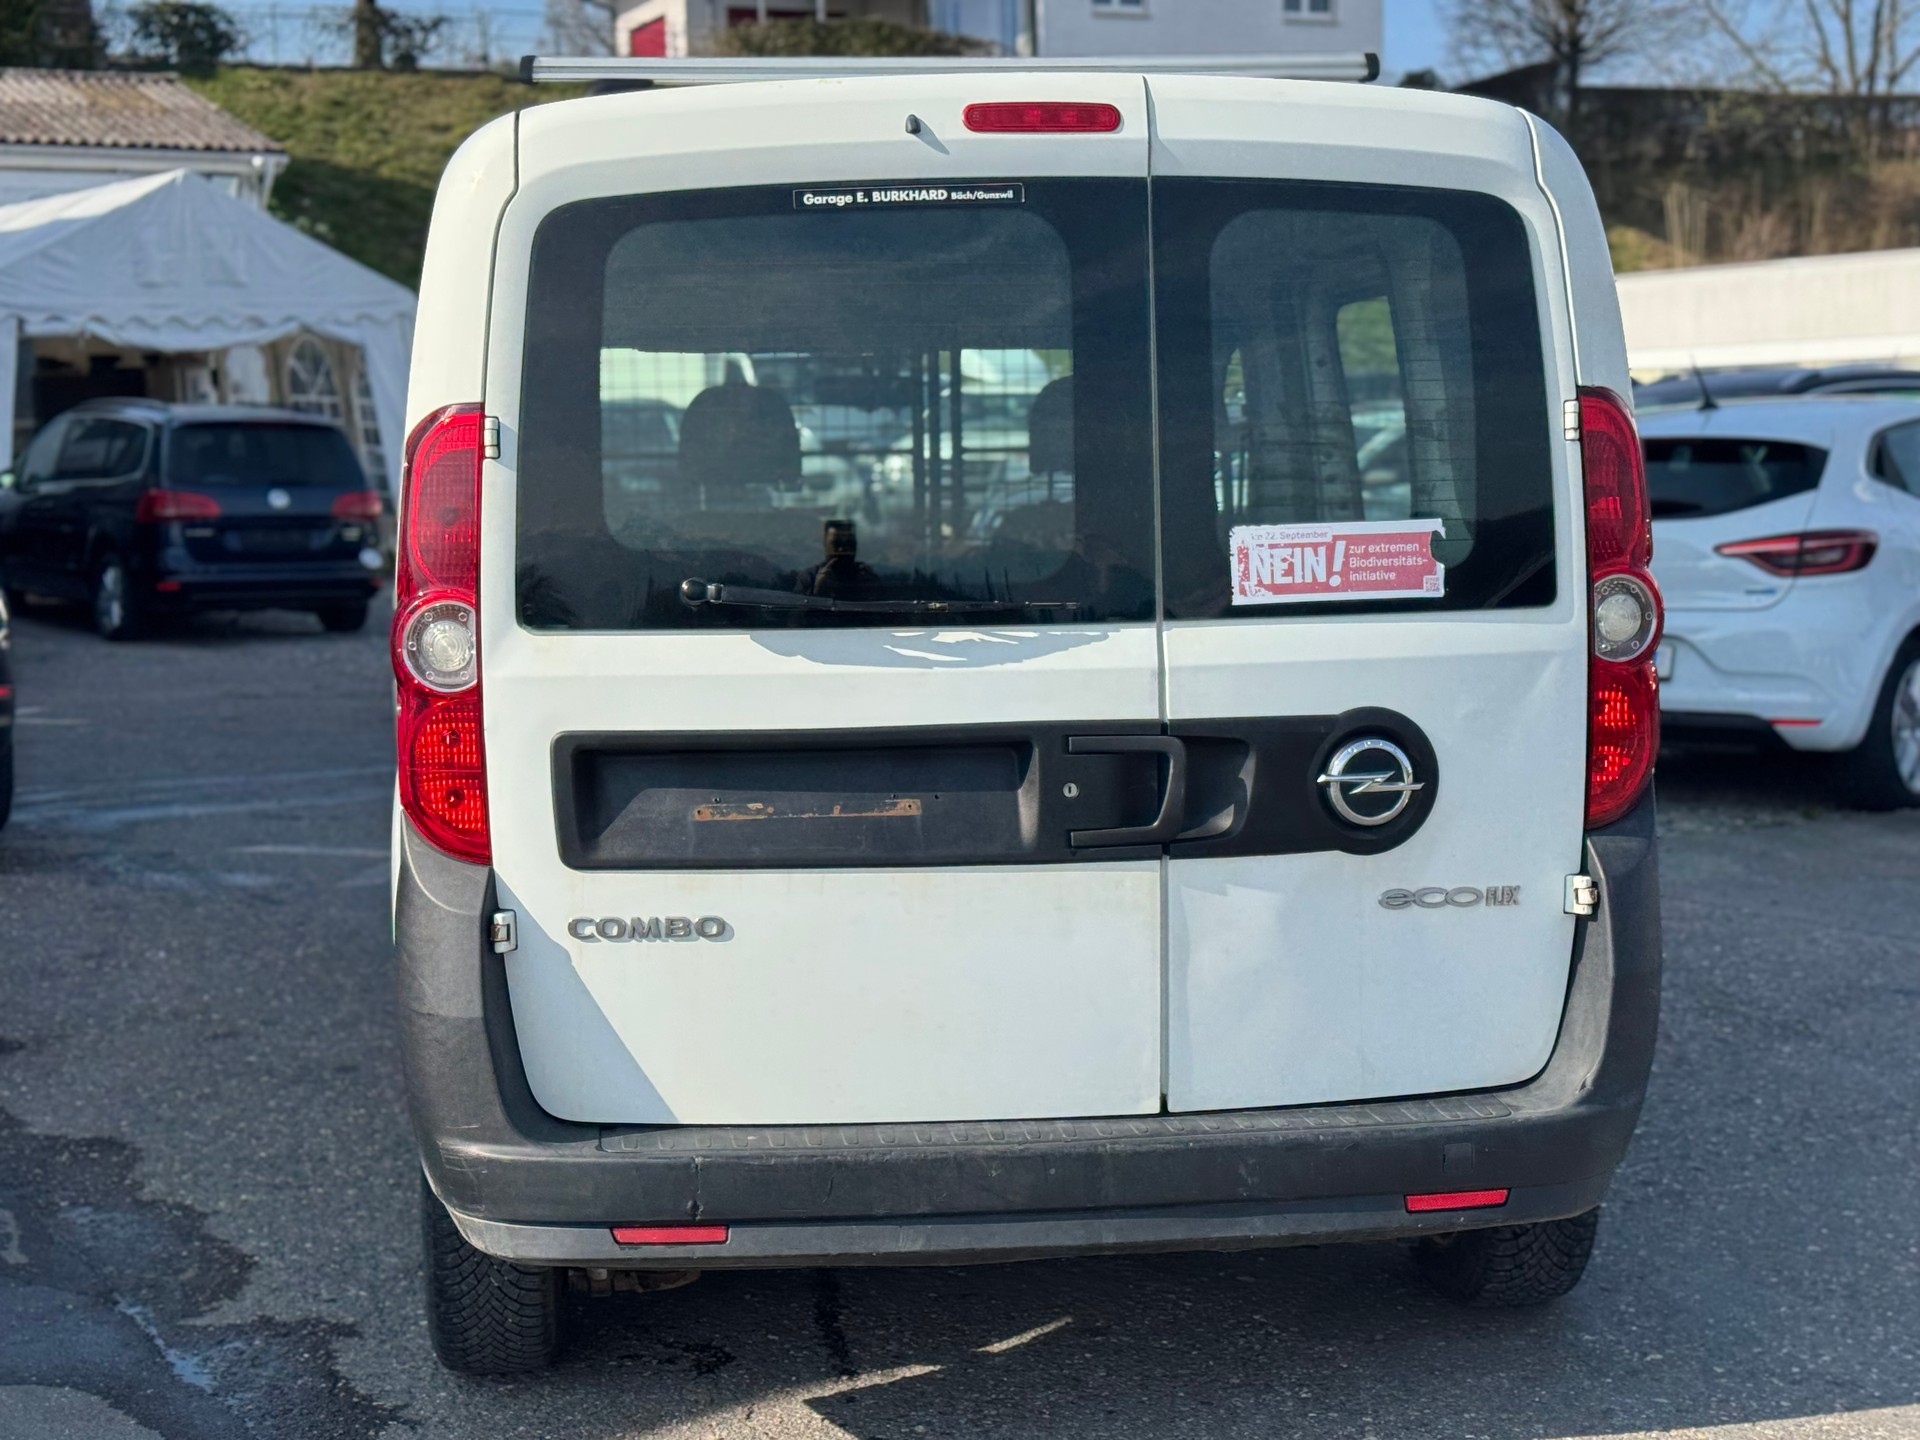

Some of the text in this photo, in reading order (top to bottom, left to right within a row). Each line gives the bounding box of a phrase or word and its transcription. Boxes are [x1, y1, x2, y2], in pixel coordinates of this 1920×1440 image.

[803, 189, 1013, 207] Garage E. BURKHARD Bäch/Gunzwil
[1280, 529, 1329, 542] September
[1349, 543, 1420, 554] zur extremen
[1249, 540, 1347, 588] NEIN!
[1349, 555, 1429, 568] Biodiversitäts-
[1349, 570, 1397, 582] initiative
[567, 916, 726, 940] COMBO
